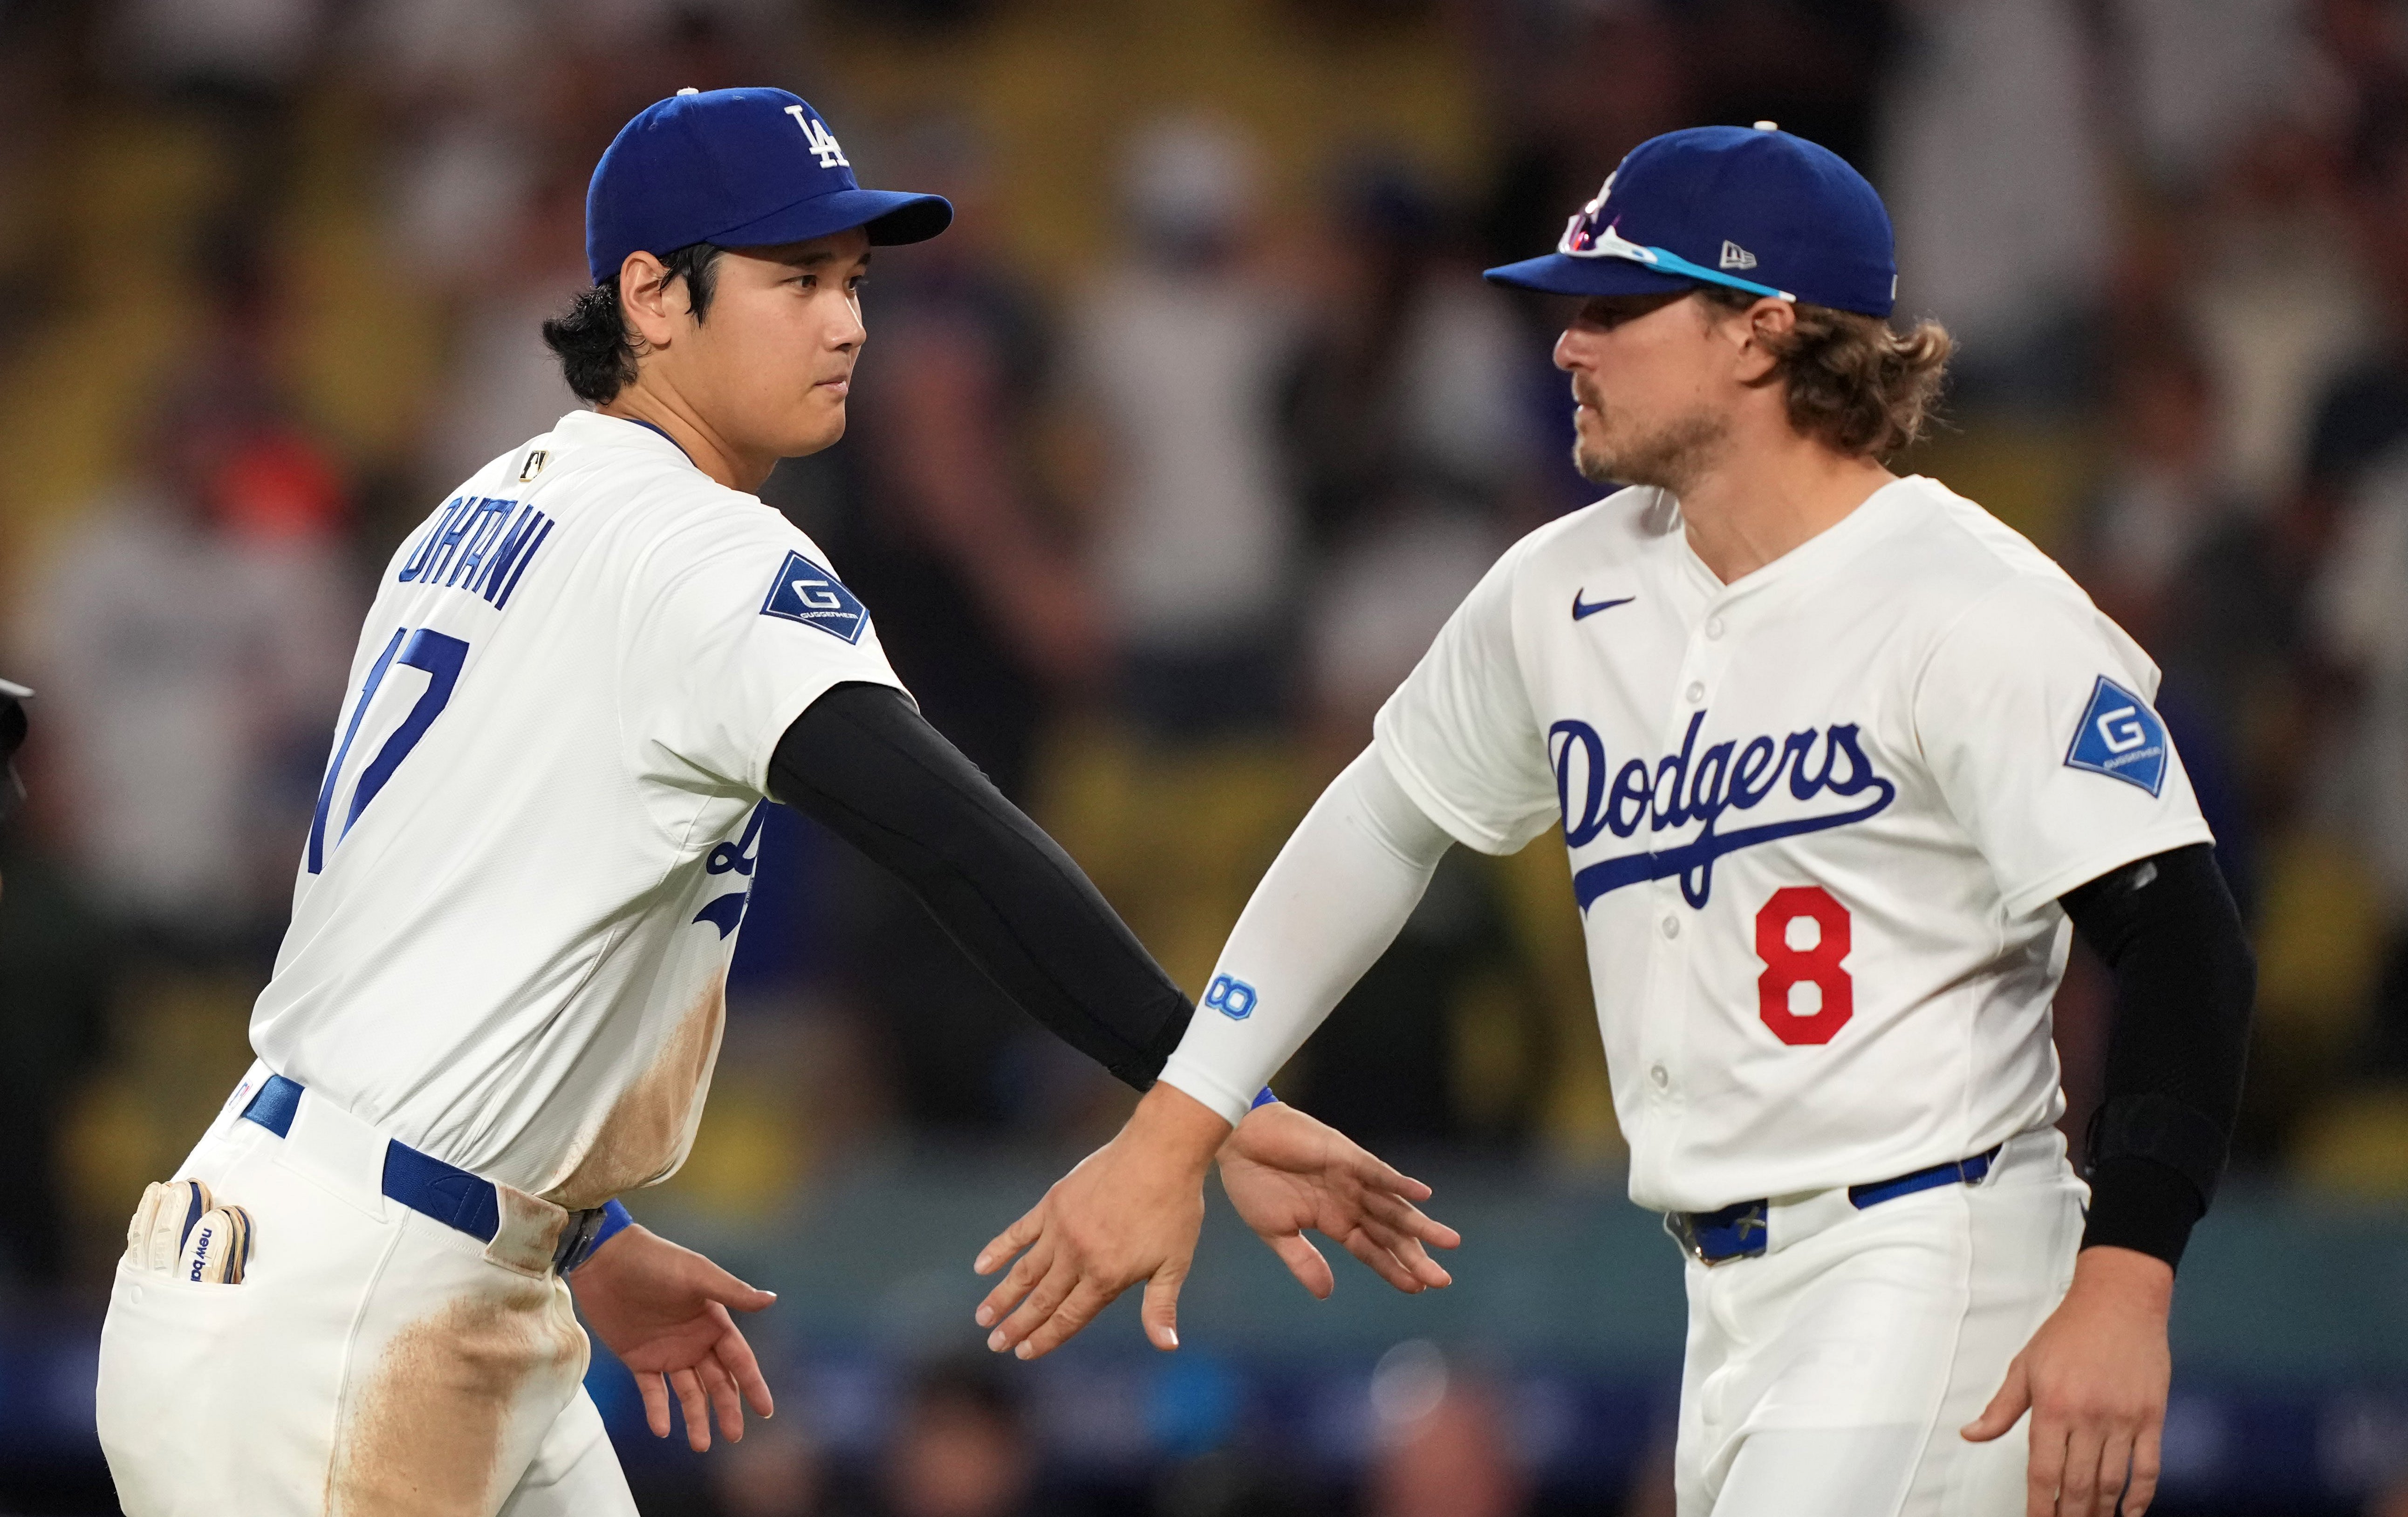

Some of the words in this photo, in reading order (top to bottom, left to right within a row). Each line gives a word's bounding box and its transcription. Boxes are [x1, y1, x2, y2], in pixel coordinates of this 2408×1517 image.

[784, 104, 850, 169] LA
[399, 496, 555, 611] OHTANI
[791, 580, 841, 609] G
[800, 611, 859, 620] GUGGENHEIM
[308, 626, 470, 875] 17
[2096, 705, 2146, 754] G
[1548, 708, 1895, 910] Dodgers
[1756, 885, 1854, 1047] 8
[1205, 972, 1258, 1021] 8
[196, 1227, 212, 1259] new
